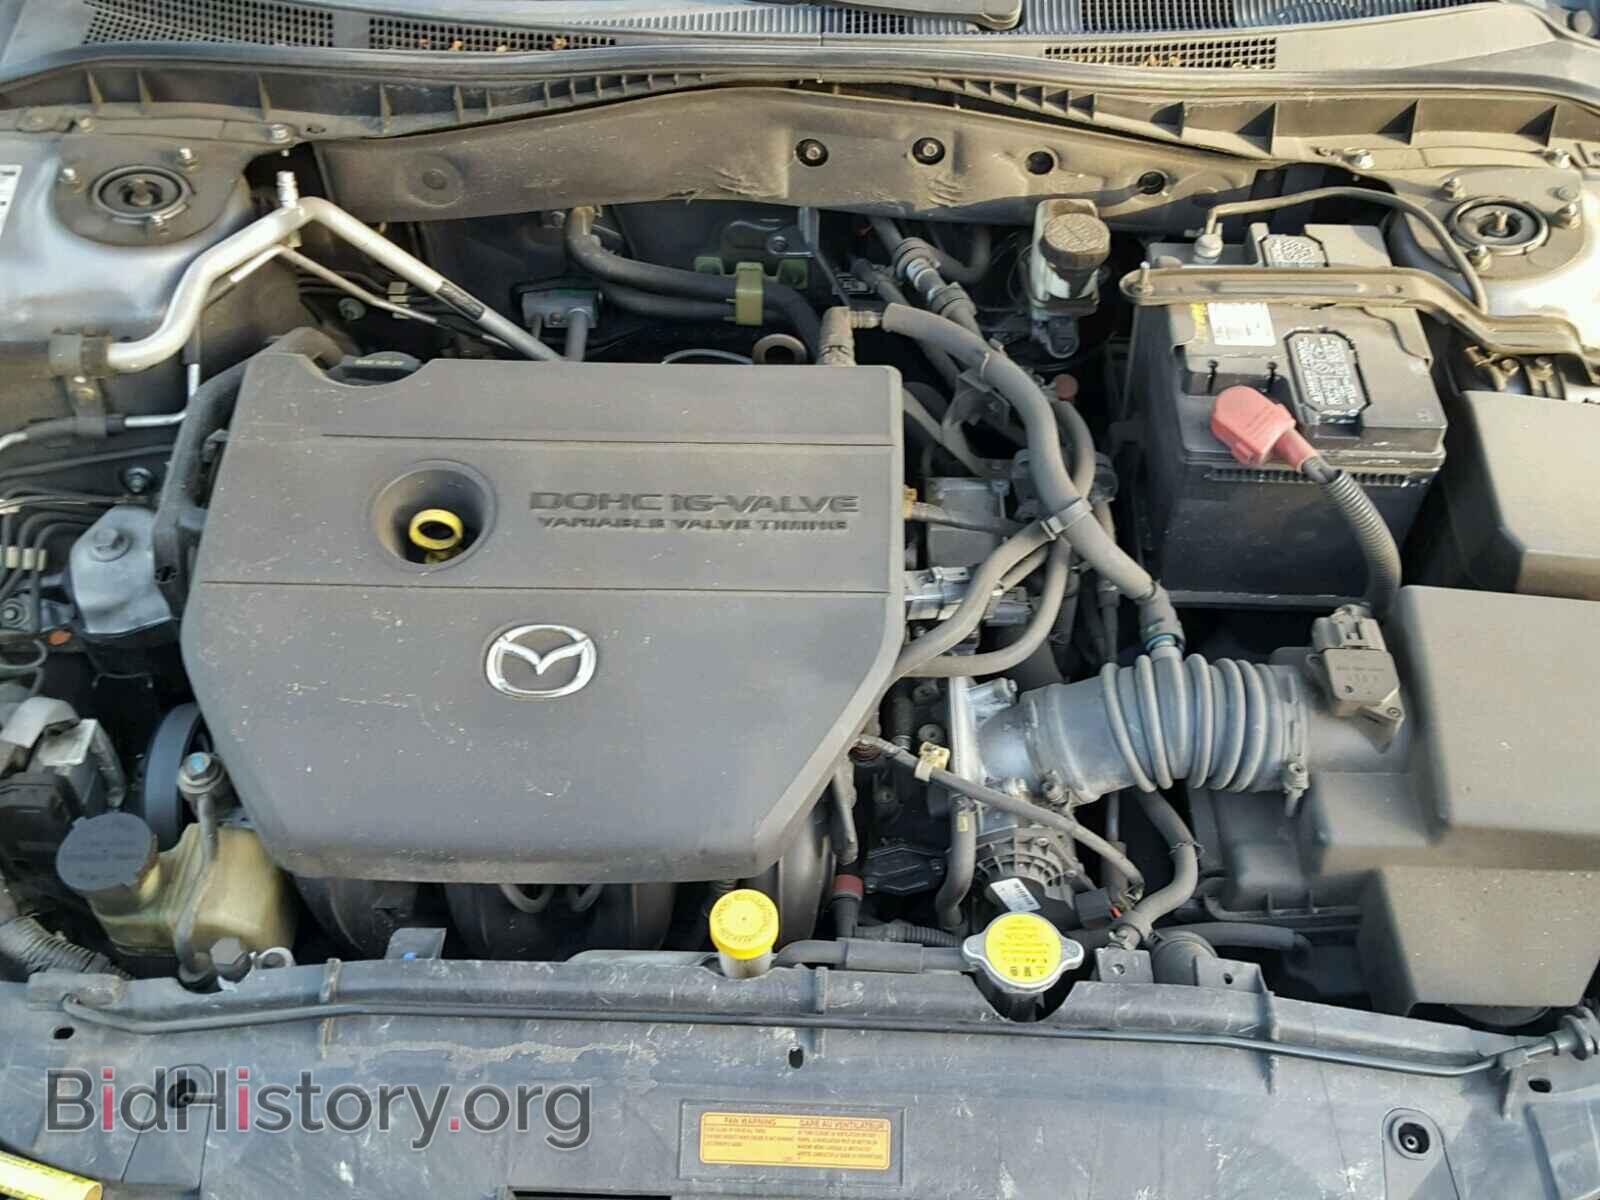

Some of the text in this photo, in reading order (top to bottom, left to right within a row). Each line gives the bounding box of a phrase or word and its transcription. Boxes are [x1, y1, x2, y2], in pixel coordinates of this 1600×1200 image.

[529, 491, 860, 514] DOHC 16-VALVE
[538, 516, 666, 529] VARIABLE
[673, 518, 752, 531] VALVE
